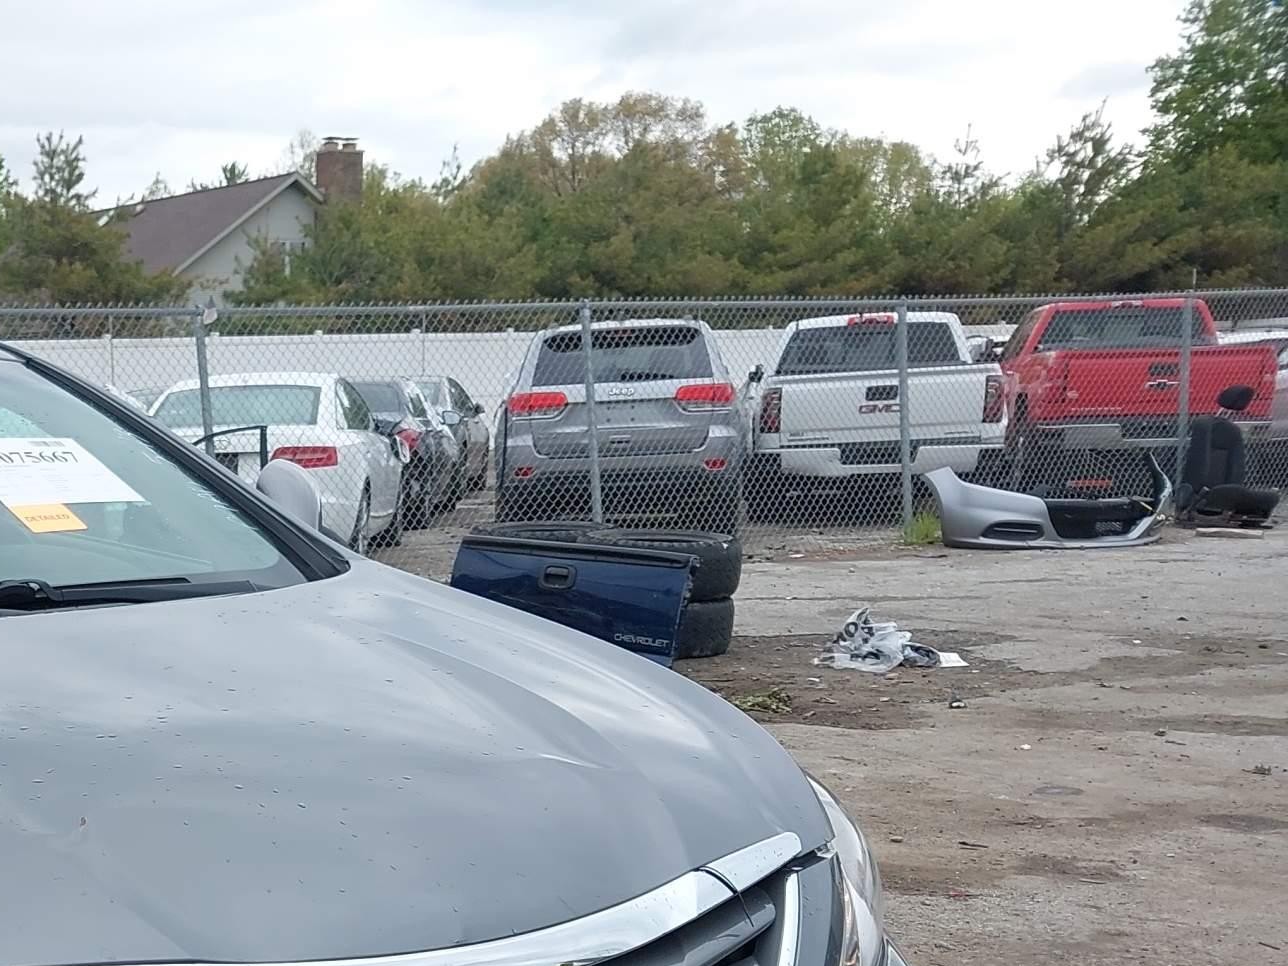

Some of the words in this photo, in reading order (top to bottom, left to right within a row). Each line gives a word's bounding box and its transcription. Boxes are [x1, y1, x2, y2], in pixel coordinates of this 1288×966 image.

[607, 386, 635, 398] Jeep
[858, 403, 902, 415] GMC
[614, 633, 670, 647] CHEVROLET
